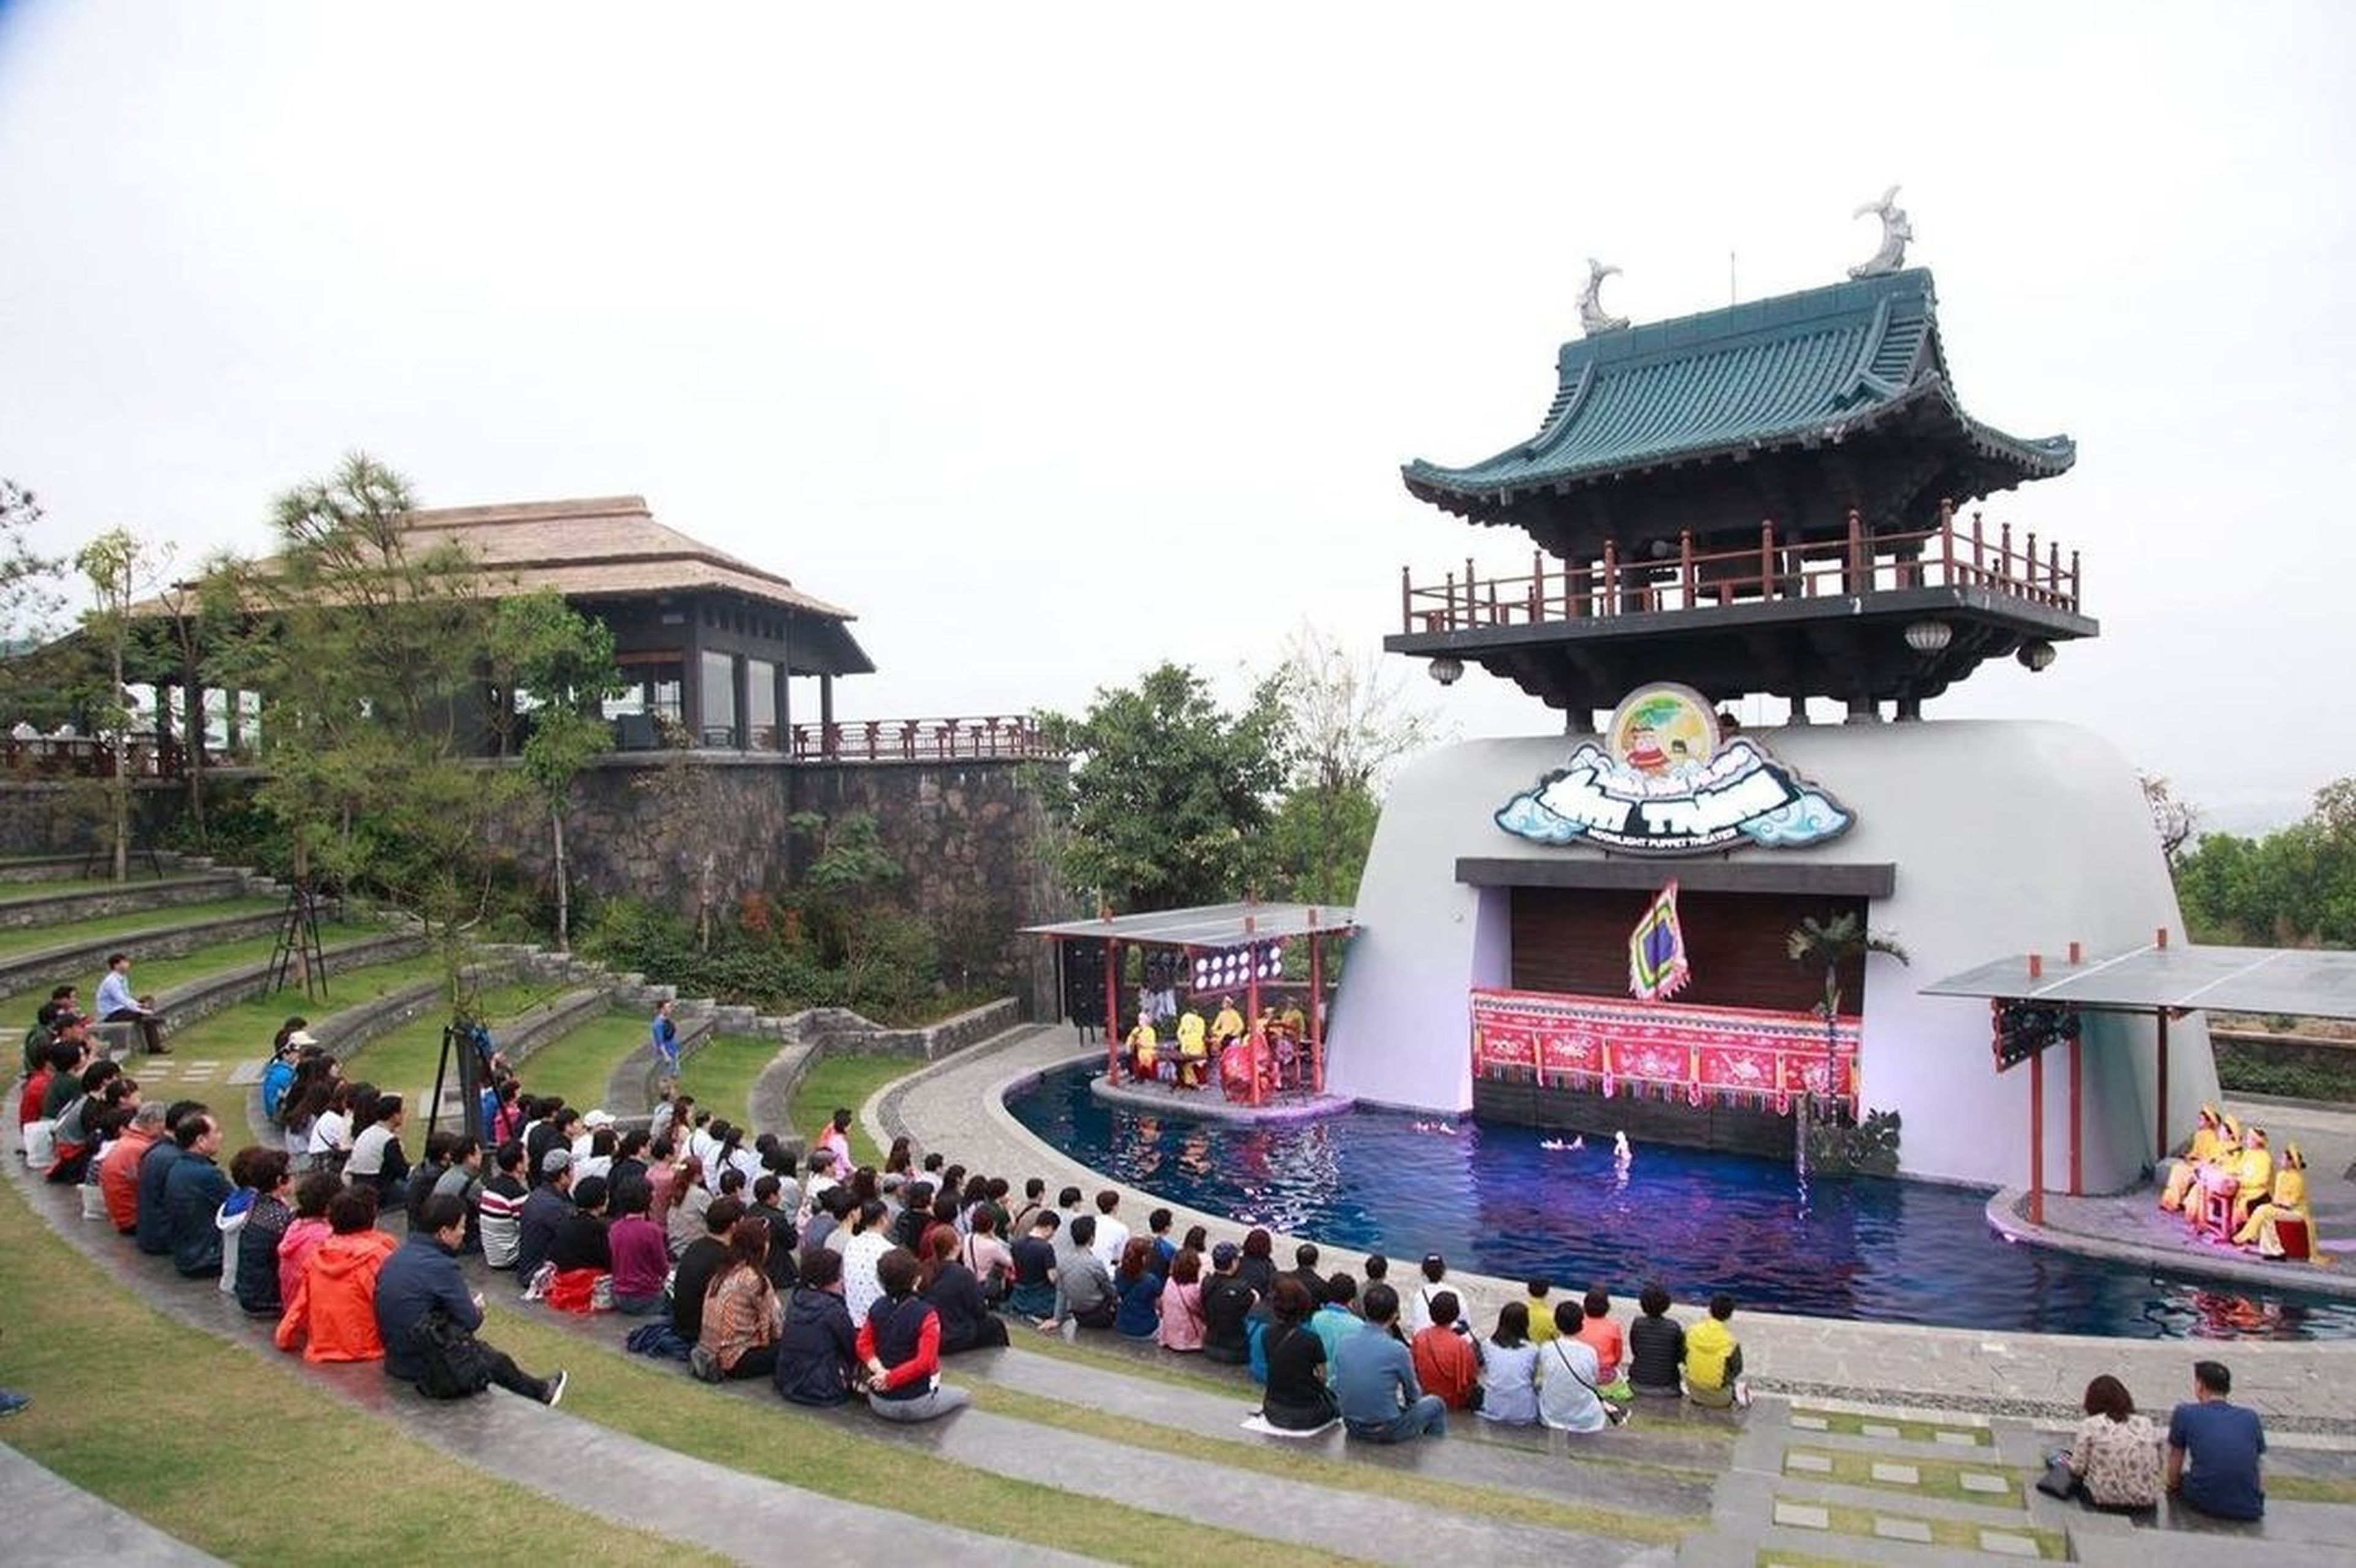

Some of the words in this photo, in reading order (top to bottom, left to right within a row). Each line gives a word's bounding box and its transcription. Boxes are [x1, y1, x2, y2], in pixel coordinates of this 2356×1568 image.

[1588, 828, 1647, 846] MOONLIGHT
[1649, 837, 1687, 848] PUPPET
[1688, 828, 1737, 846] THEATER
